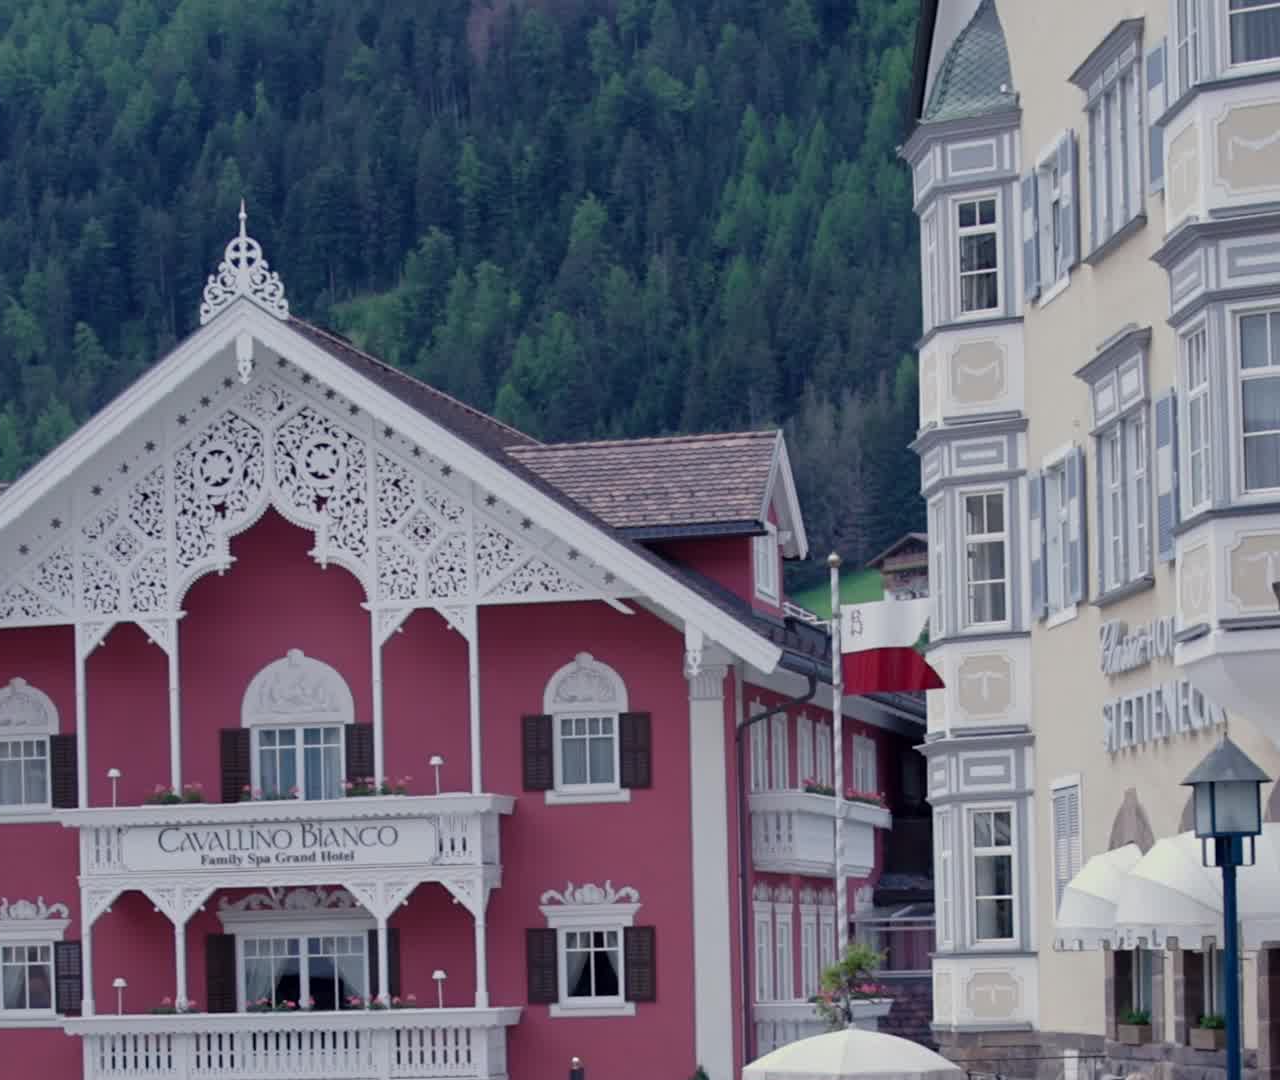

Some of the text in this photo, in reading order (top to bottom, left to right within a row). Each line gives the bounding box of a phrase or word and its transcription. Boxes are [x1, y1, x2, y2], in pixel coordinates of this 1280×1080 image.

[200, 850, 355, 867] Family Spa Grand Hotel
